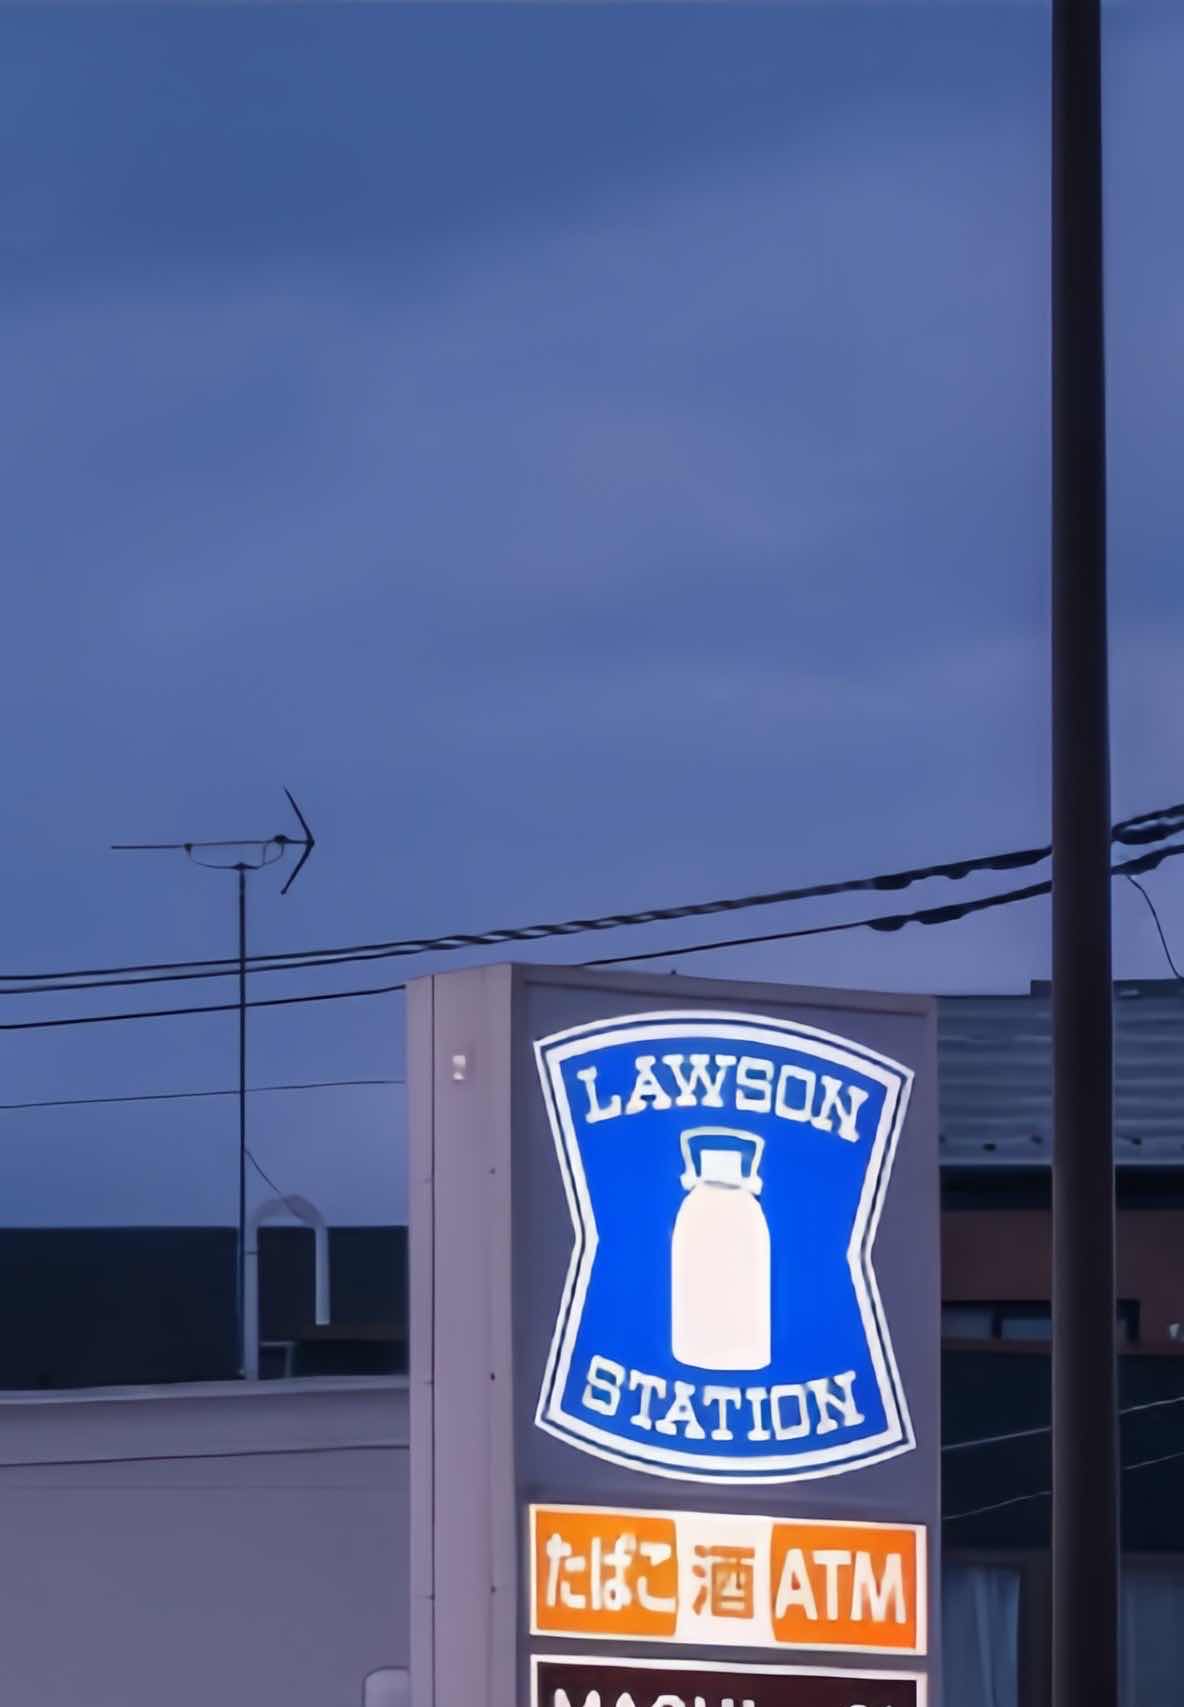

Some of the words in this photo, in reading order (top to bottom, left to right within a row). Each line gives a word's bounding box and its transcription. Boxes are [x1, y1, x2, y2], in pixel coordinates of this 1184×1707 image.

[577, 1053, 869, 1143] LAWSON
[582, 1355, 865, 1441] STATION
[546, 1532, 678, 1611] たばこ
[691, 1544, 755, 1620] 酒
[774, 1547, 907, 1625] ATM
